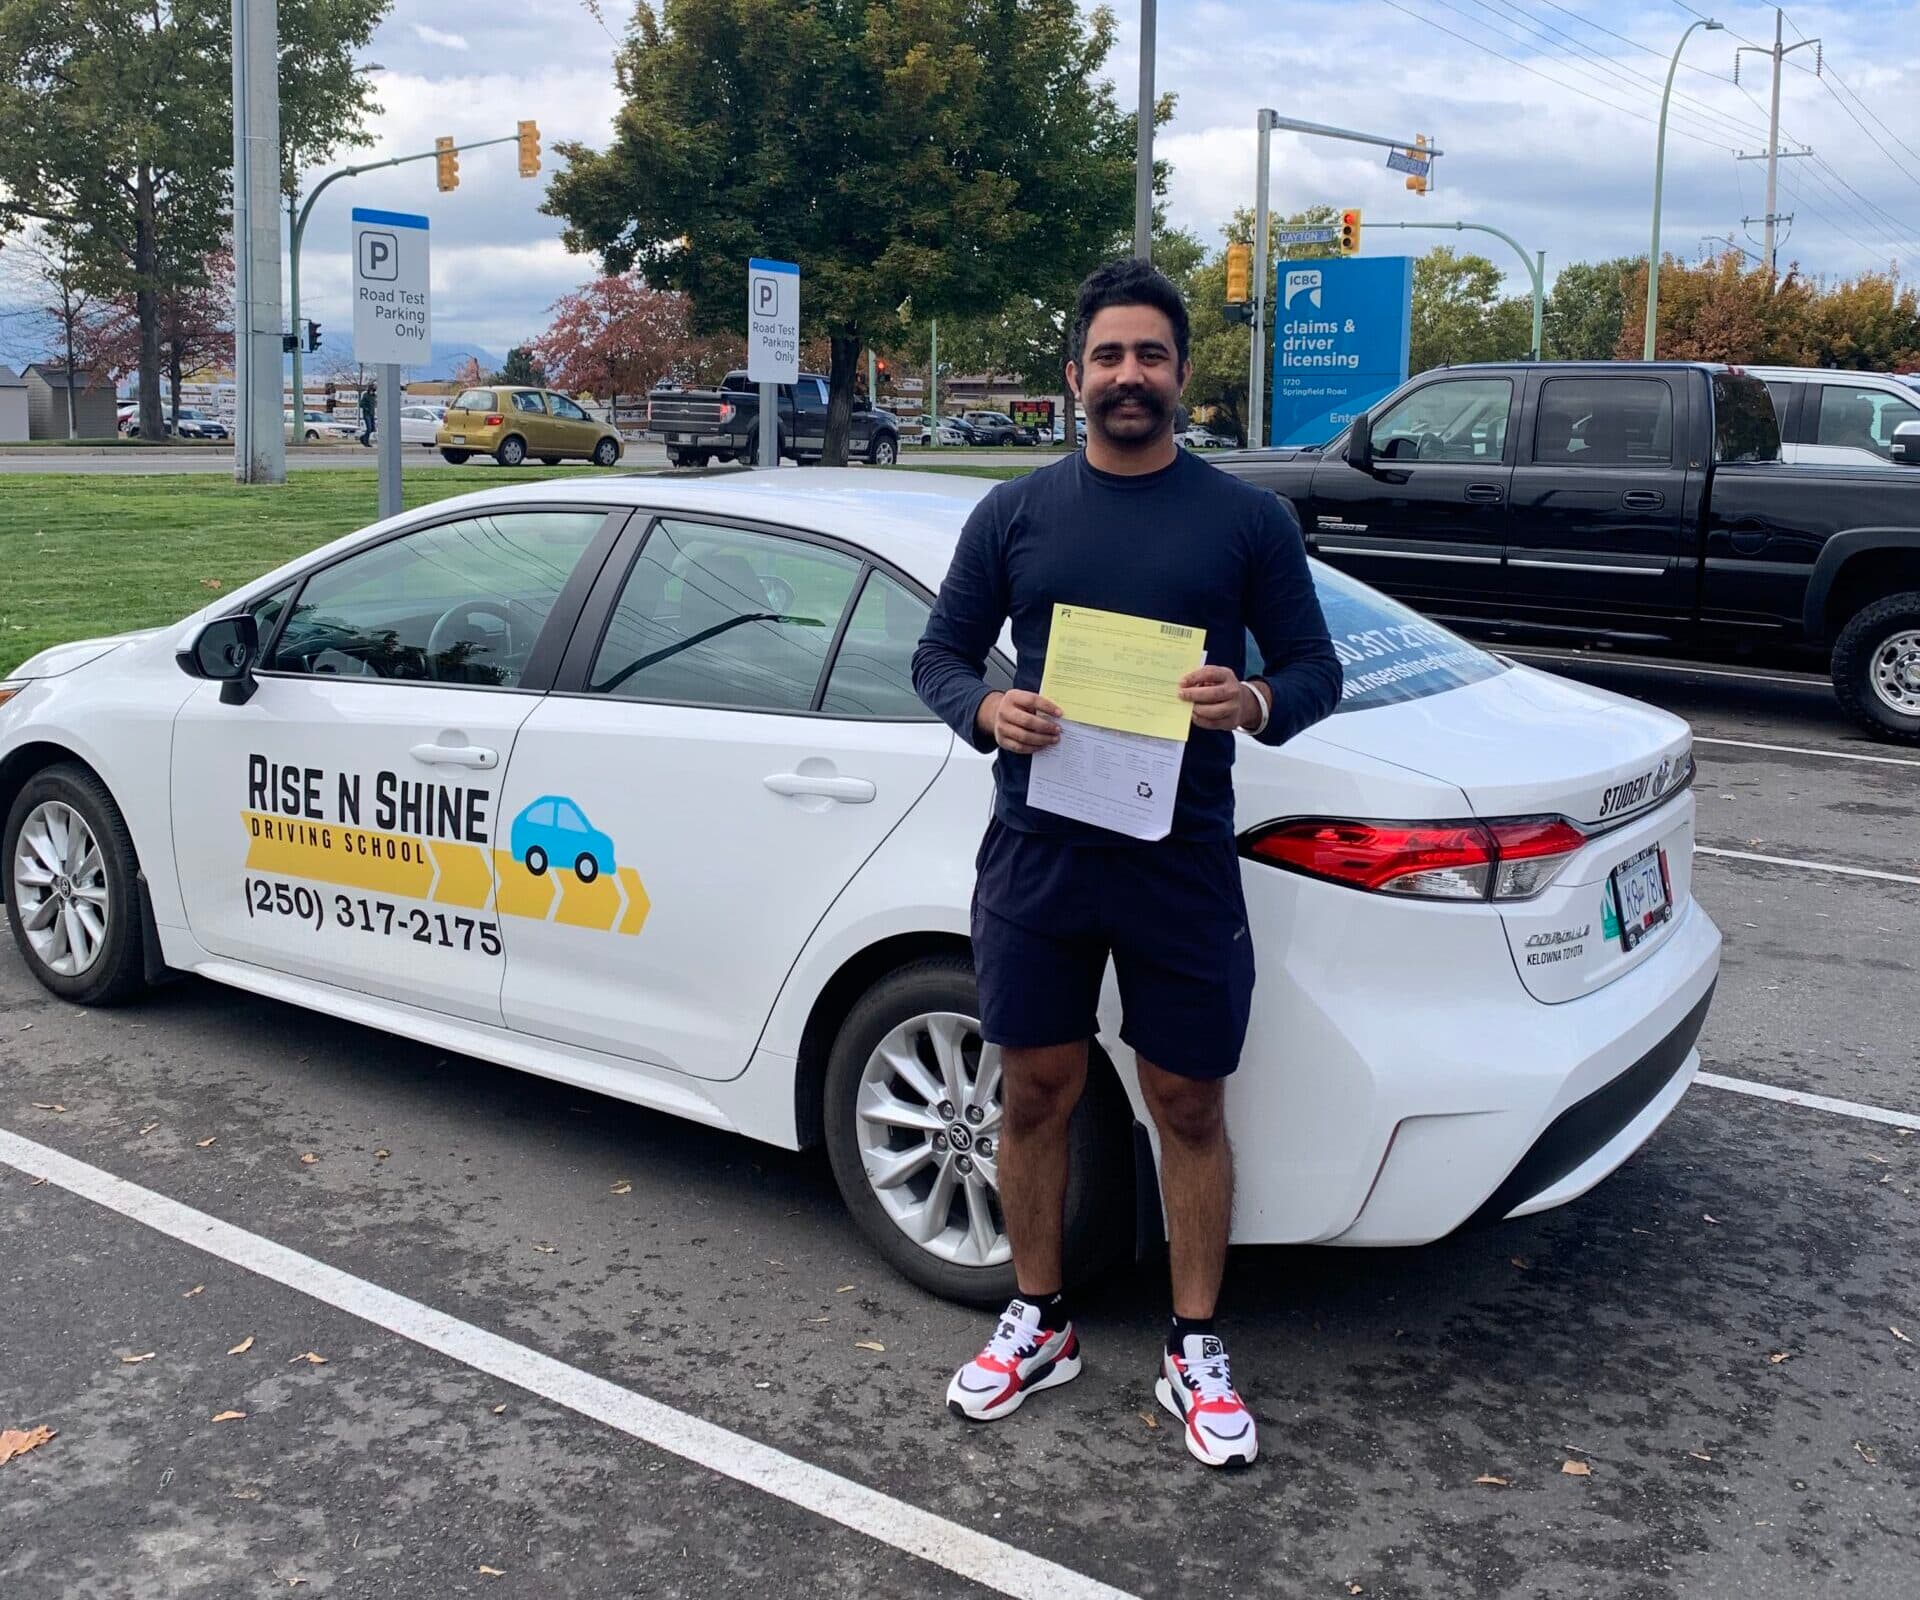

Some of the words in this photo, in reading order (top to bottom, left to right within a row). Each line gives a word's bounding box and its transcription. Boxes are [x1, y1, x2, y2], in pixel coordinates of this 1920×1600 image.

[1280, 230, 1319, 242] DAYTON
[370, 240, 389, 270] P
[1289, 274, 1319, 286] ICBC
[359, 286, 395, 303] Road
[399, 290, 425, 305] Test
[760, 285, 772, 308] P
[375, 305, 425, 324] Parking
[394, 323, 426, 341] Only
[753, 321, 776, 334] Road
[778, 323, 796, 336] Test
[1283, 319, 1339, 335] claims
[1343, 318, 1356, 334] &
[762, 335, 795, 351] Parking
[1282, 335, 1335, 351] driver
[774, 350, 795, 364] Only
[1282, 351, 1360, 369] licensing
[1282, 378, 1301, 387] 1720
[1282, 387, 1325, 397] Springfield
[1326, 387, 1348, 396] Road
[248, 753, 324, 820] RISE
[338, 772, 361, 826] N
[375, 770, 490, 844] SHINE
[1598, 771, 1653, 817] STUDENT
[251, 817, 332, 849] DRIVING
[344, 832, 424, 864] SCHOOL
[245, 876, 325, 932] (250)
[334, 894, 502, 957] 317-2175
[1526, 949, 1562, 967] KELOWNA
[1562, 943, 1584, 961] TOYOTA
